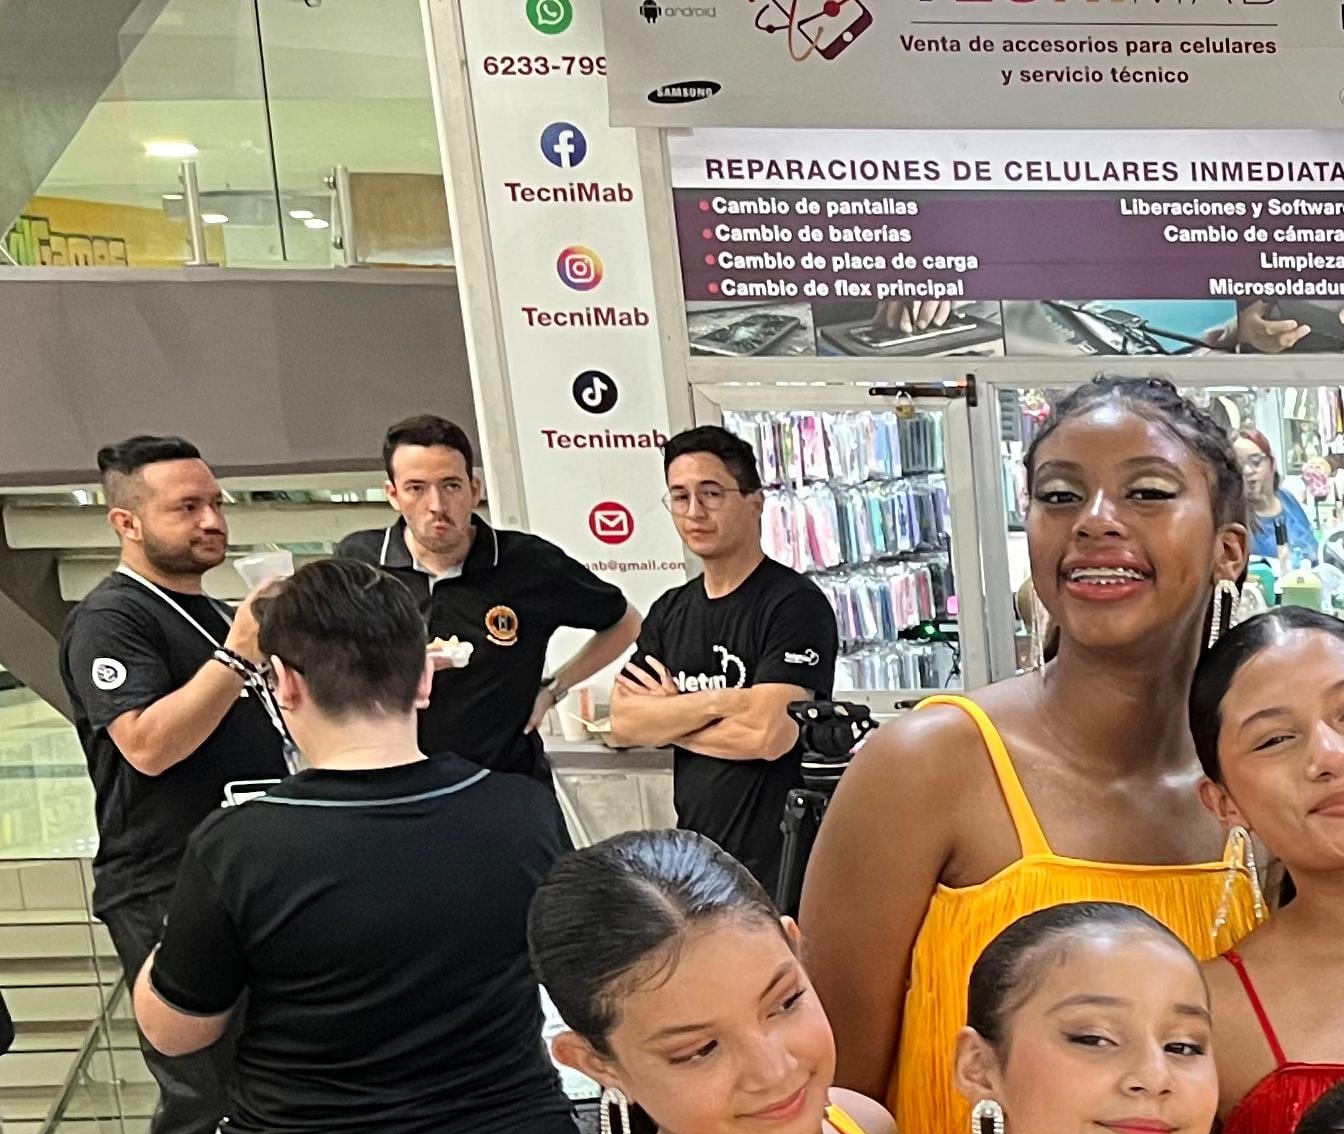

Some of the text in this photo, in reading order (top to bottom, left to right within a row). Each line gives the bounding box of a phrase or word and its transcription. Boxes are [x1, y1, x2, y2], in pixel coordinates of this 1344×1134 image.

[664, 7, 716, 18] android
[899, 34, 1277, 57] Venta de accesorios para celulares
[1001, 66, 1190, 86] y servicio técnico
[706, 159, 941, 181] REPARACIONES
[953, 161, 992, 181] DE
[1004, 161, 1179, 182] CELULARES
[504, 182, 635, 203] TecniMab
[711, 197, 919, 217] Cambio de pantallas
[1120, 199, 1247, 216] Liberaciones
[1252, 204, 1264, 218] y
[715, 225, 912, 243] Cambio de baterías
[1163, 226, 1239, 243] Cambio
[1244, 226, 1268, 243] de
[718, 252, 979, 272] Cambio de placa de carga
[720, 279, 965, 299] Cambio de flex principal
[521, 306, 650, 328] TecniMab
[541, 430, 668, 449] Tecnimab
